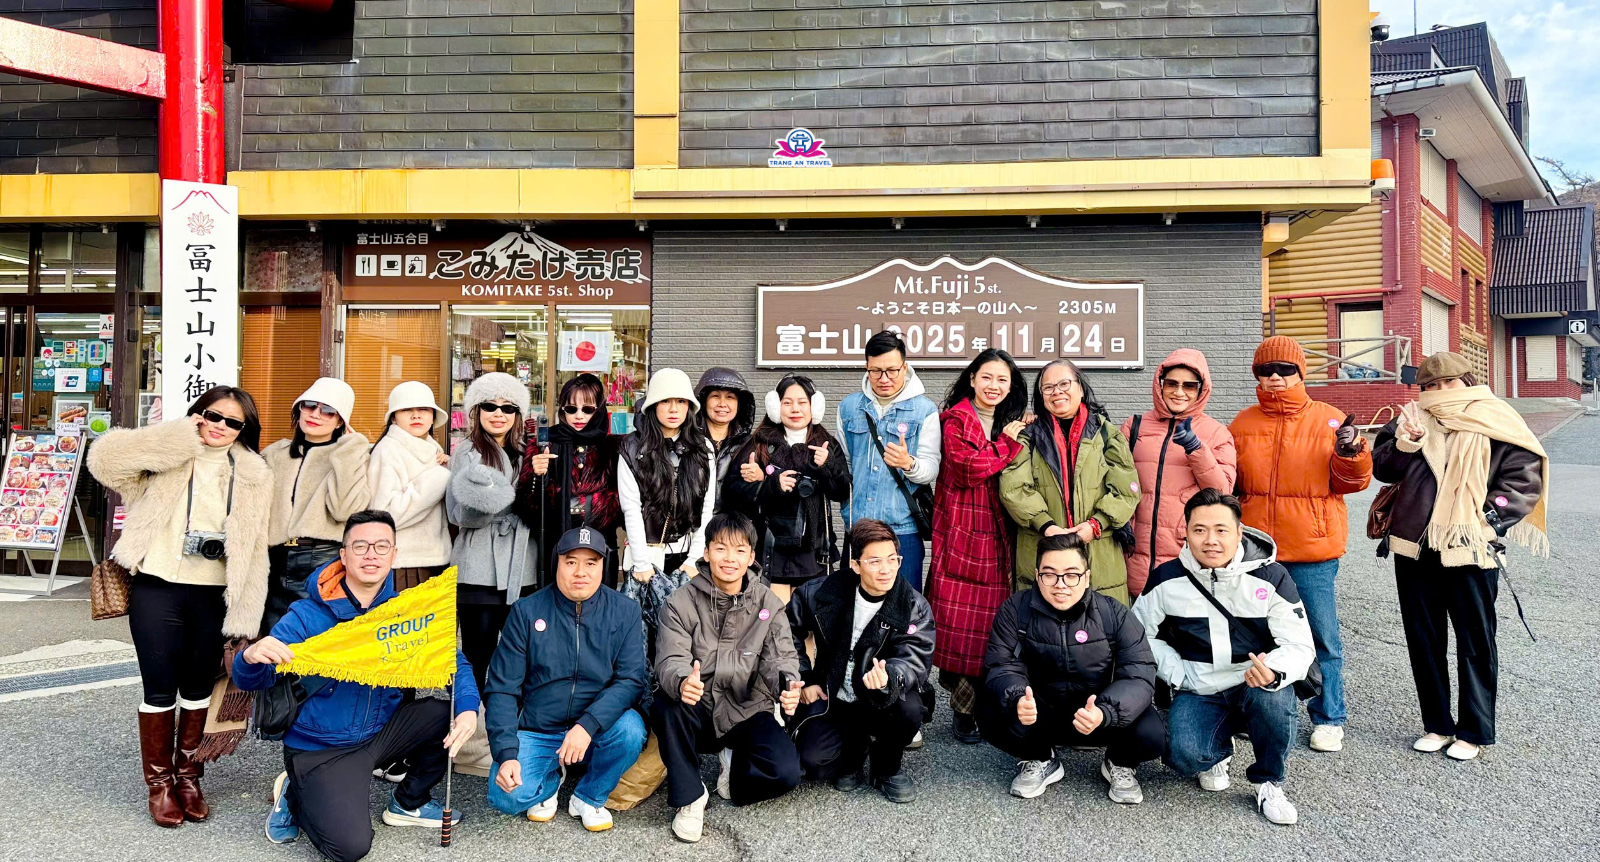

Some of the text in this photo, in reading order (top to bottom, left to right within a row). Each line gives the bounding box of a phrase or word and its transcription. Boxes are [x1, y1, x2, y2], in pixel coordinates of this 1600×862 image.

[357, 232, 428, 245] 富士山五合目
[436, 247, 642, 281] こみたけ売店
[461, 283, 614, 300] KOMITAKE 5st. Shop
[894, 274, 969, 300] Mt.Fuji
[1058, 300, 1116, 314] 2305M
[776, 323, 872, 354] 富士山
[1063, 324, 1103, 353] 24
[377, 613, 435, 641] GROUP
[382, 632, 429, 654] Travel
